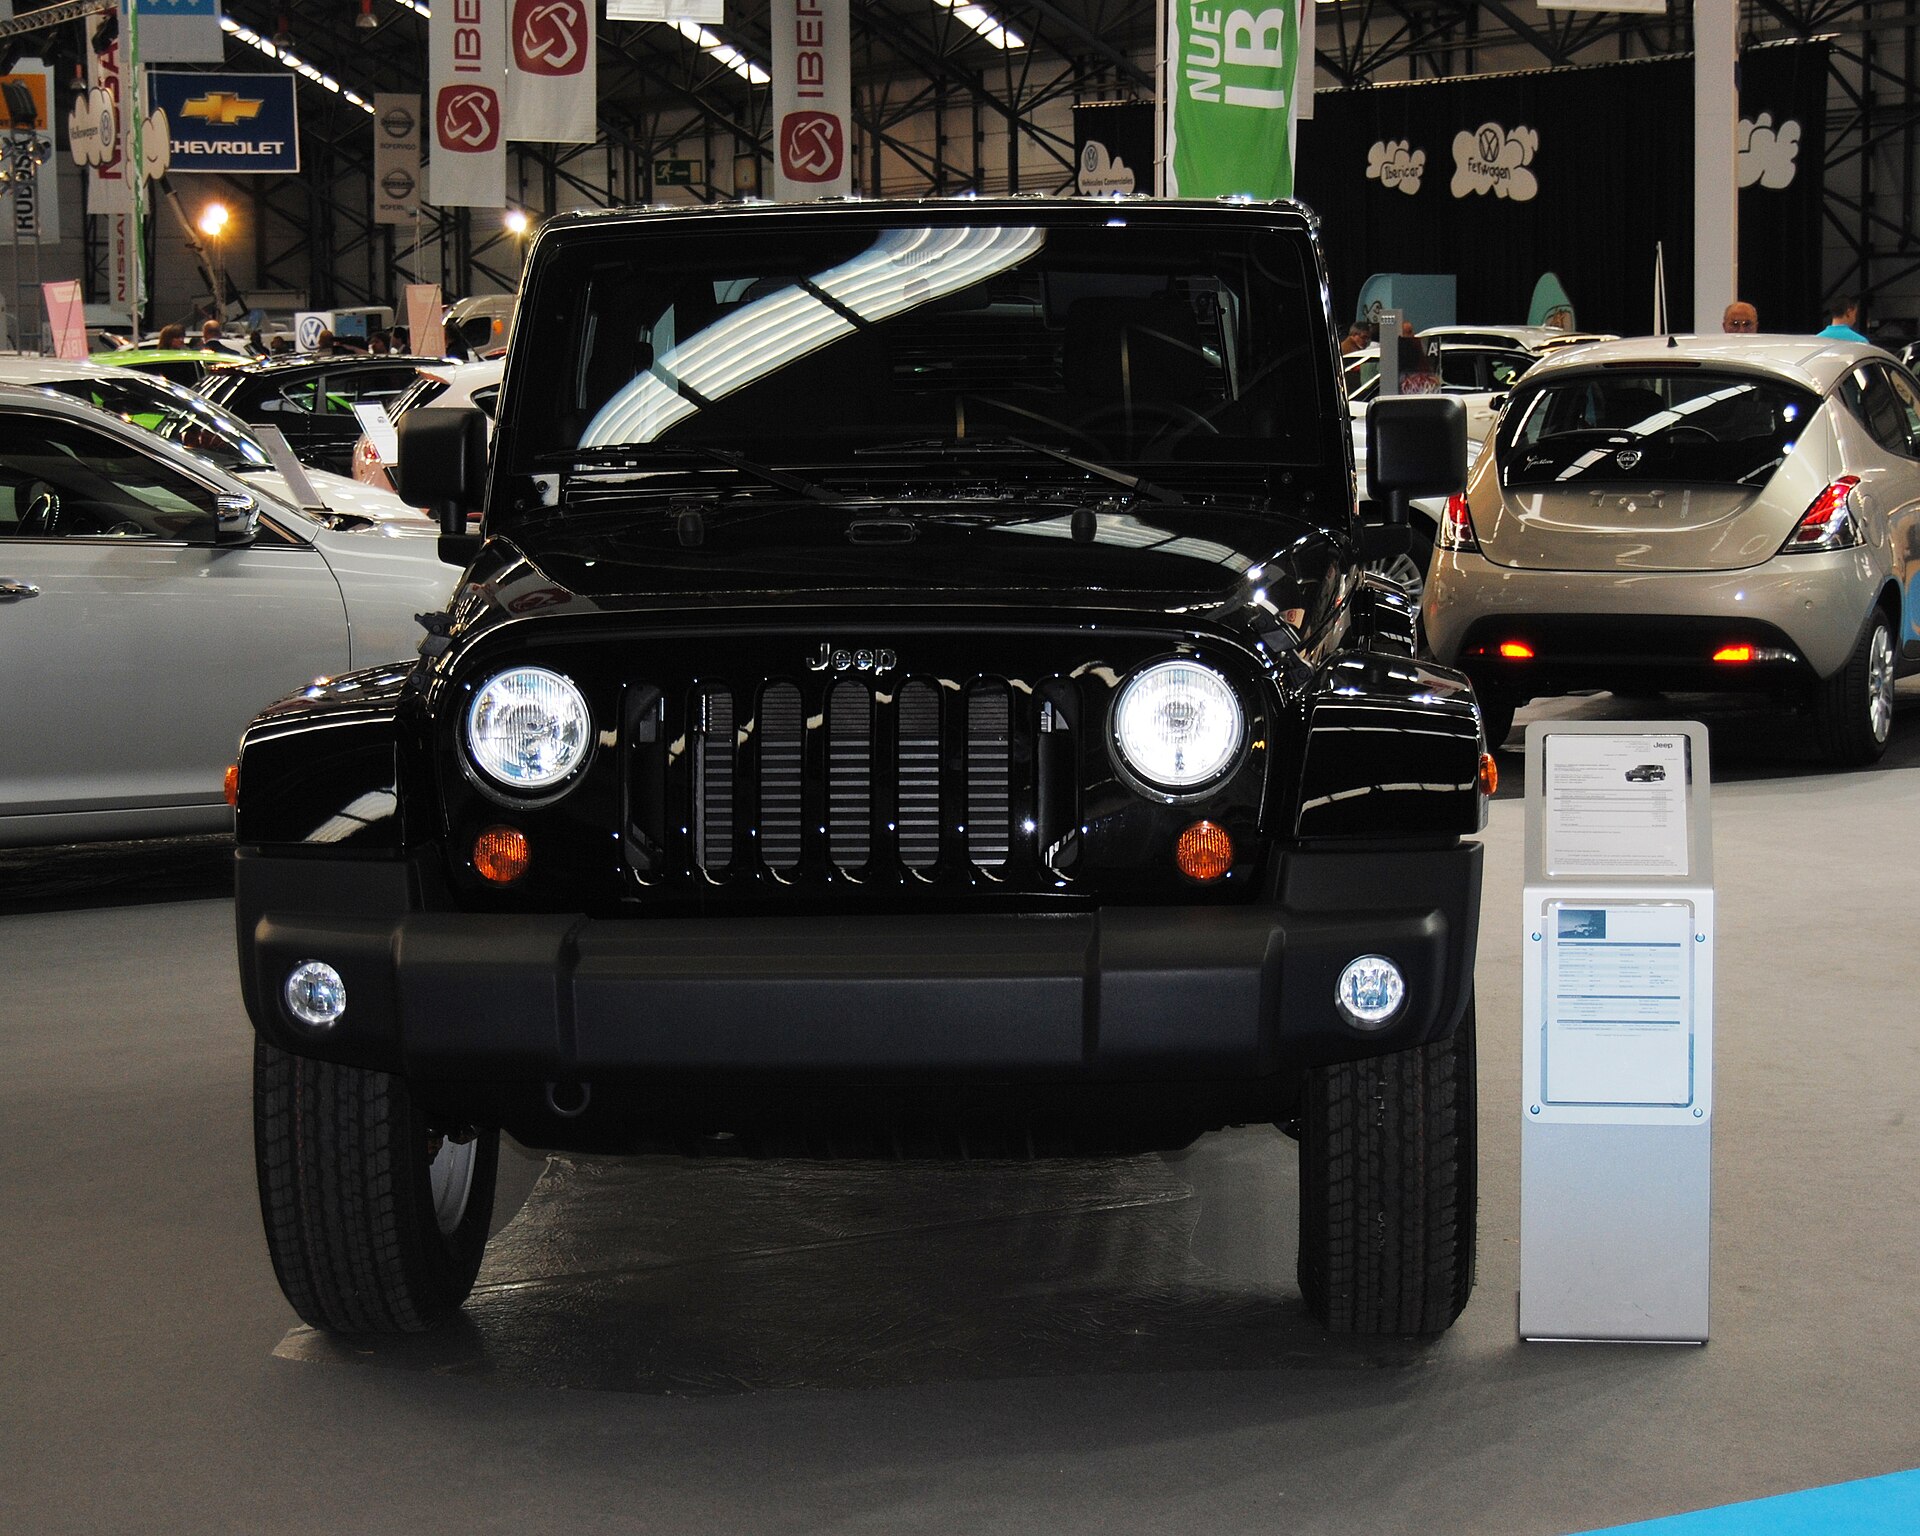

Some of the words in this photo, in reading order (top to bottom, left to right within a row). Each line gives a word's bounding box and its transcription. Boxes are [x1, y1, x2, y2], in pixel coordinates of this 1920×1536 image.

[1186, 0, 1221, 103] NUE
[116, 213, 126, 302] NISSA
[805, 642, 898, 676] Jeep
[1652, 741, 1674, 749] Jeep
